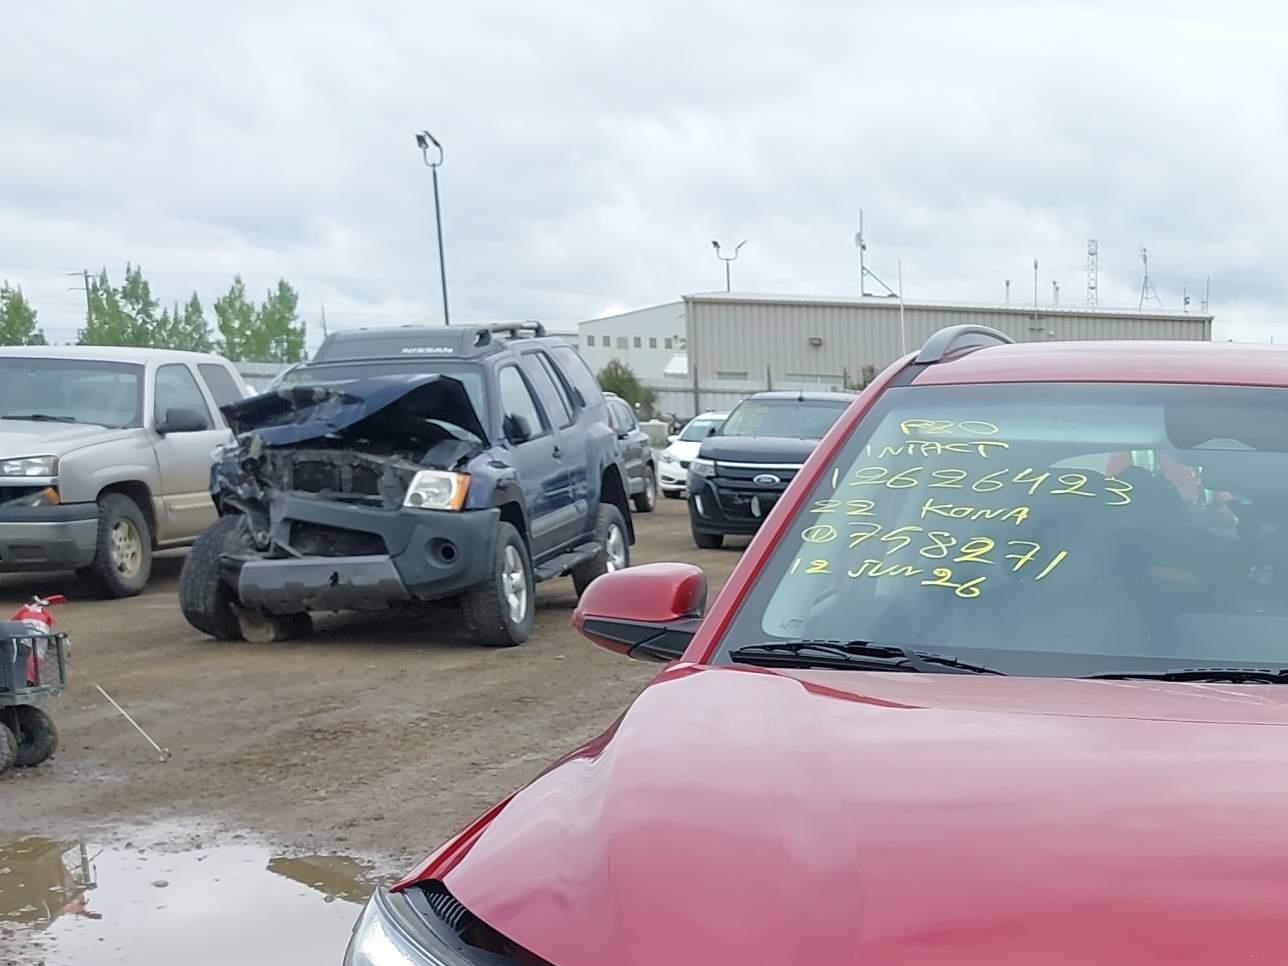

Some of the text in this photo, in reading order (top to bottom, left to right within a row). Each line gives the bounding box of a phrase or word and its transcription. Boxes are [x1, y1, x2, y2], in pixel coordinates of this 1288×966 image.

[866, 440, 1010, 458] INTACT
[832, 466, 1134, 506] 12626423
[810, 499, 876, 516] 22
[790, 558, 833, 575] 12
[920, 568, 987, 598] 26
